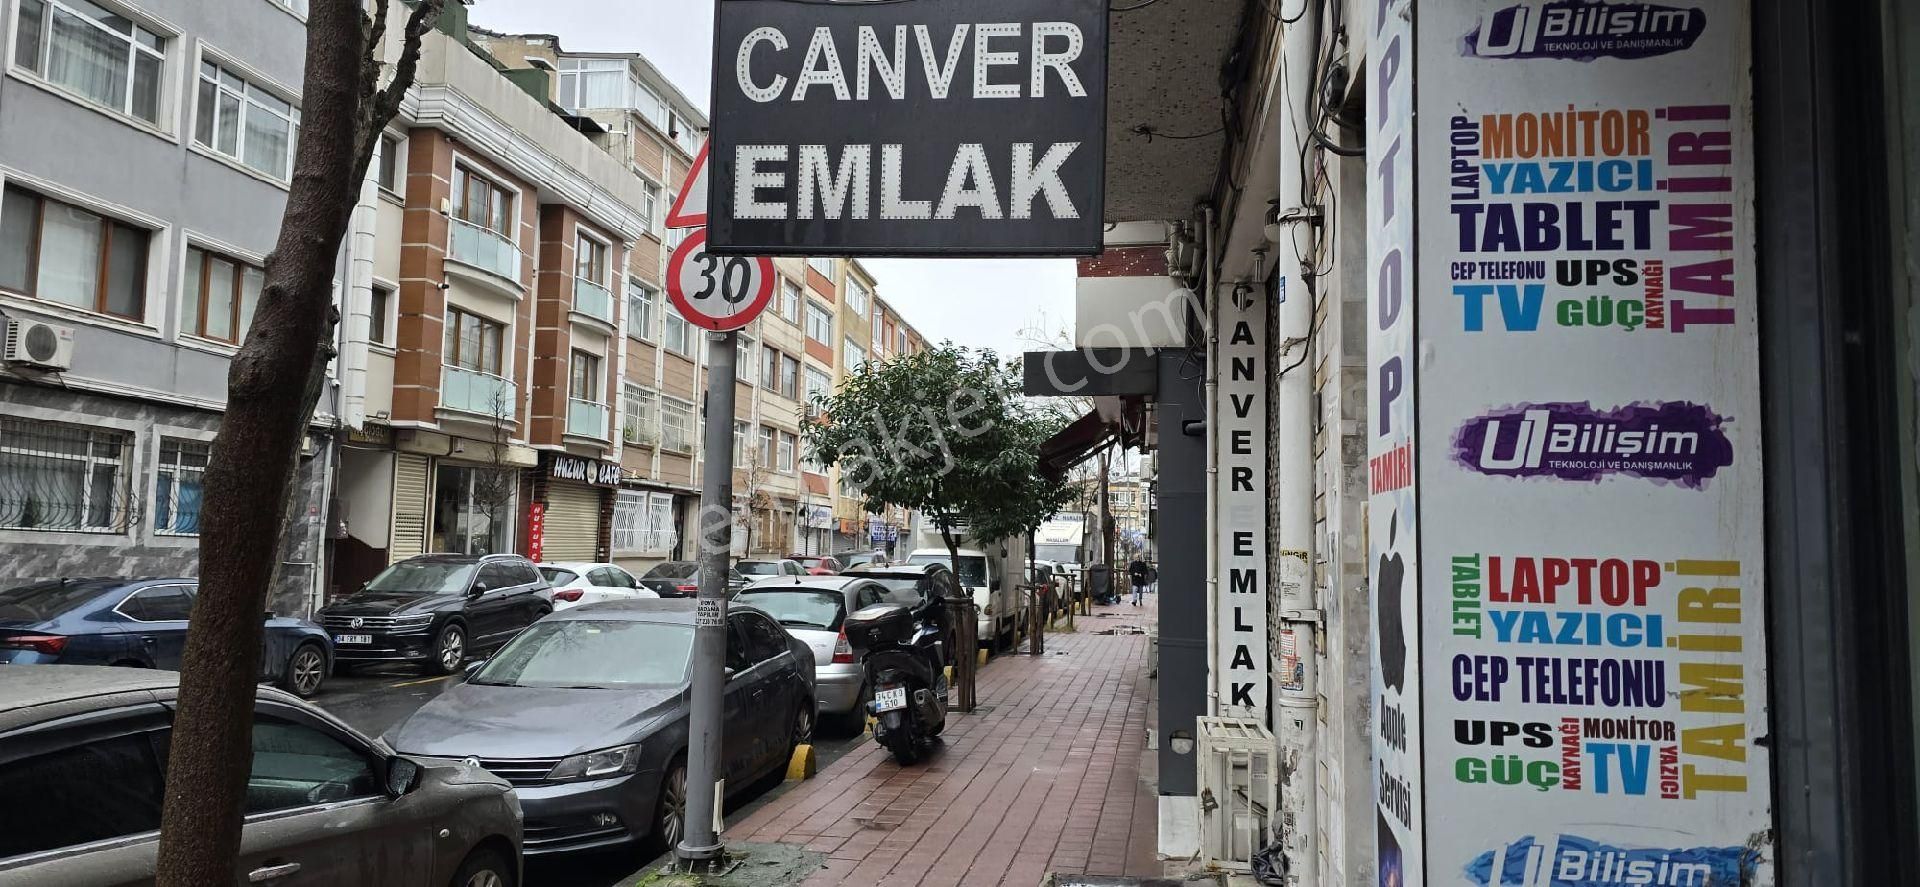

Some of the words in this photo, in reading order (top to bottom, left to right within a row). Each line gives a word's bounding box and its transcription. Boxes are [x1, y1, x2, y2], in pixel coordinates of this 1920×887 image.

[1543, 6, 1691, 37] Bilişim
[1544, 41, 1598, 51] TEKNOLOJİ
[1600, 41, 1613, 50] VE
[1616, 38, 1684, 49] DANIŞMANLIK
[736, 21, 1088, 102] CANVER
[1451, 115, 1480, 200] LAPTOP
[1482, 104, 1650, 159] MONİTOR
[733, 141, 1081, 220] EMLAK
[1482, 159, 1653, 194] YAZICI
[1451, 200, 1660, 253] TABLET
[1655, 105, 1735, 333] TAMİRİ
[693, 252, 752, 304] 30
[1451, 261, 1477, 281] CEP
[1479, 260, 1546, 281] TELEFONU
[1556, 258, 1639, 287] UPS
[1641, 260, 1665, 329] KAYNAĞI
[1453, 284, 1546, 332] TV
[1557, 295, 1644, 332] GÜÇ
[1230, 284, 1255, 492] CANVER
[1548, 424, 1698, 458] Bilişim
[1549, 459, 1605, 470] TEKNOLOJİ
[1607, 461, 1621, 470] VE
[1623, 461, 1693, 471] DANIŞMANLIK
[553, 457, 585, 481] HUZUR
[599, 464, 620, 485] CAFE
[1369, 441, 1412, 496] TAMİRİ
[1452, 552, 1481, 639] TABLET
[1488, 556, 1661, 606] LAPTOP
[1230, 531, 1258, 707] EMLAK
[1487, 610, 1663, 648] YAZICI
[1452, 654, 1509, 702] CEP
[1516, 656, 1666, 708] TELEFONU
[1664, 559, 1747, 800] TAMİRİ
[1380, 694, 1407, 754] Apple
[1454, 719, 1554, 748] UPS
[1583, 715, 1676, 741] MONİTOR
[1455, 754, 1560, 791] GÜÇ
[1558, 717, 1582, 790] KAYNAĞI
[1585, 743, 1651, 795] TV
[1659, 745, 1679, 799] YAZICI
[1379, 758, 1412, 831] Servisi
[1558, 849, 1711, 887] Bilişim
